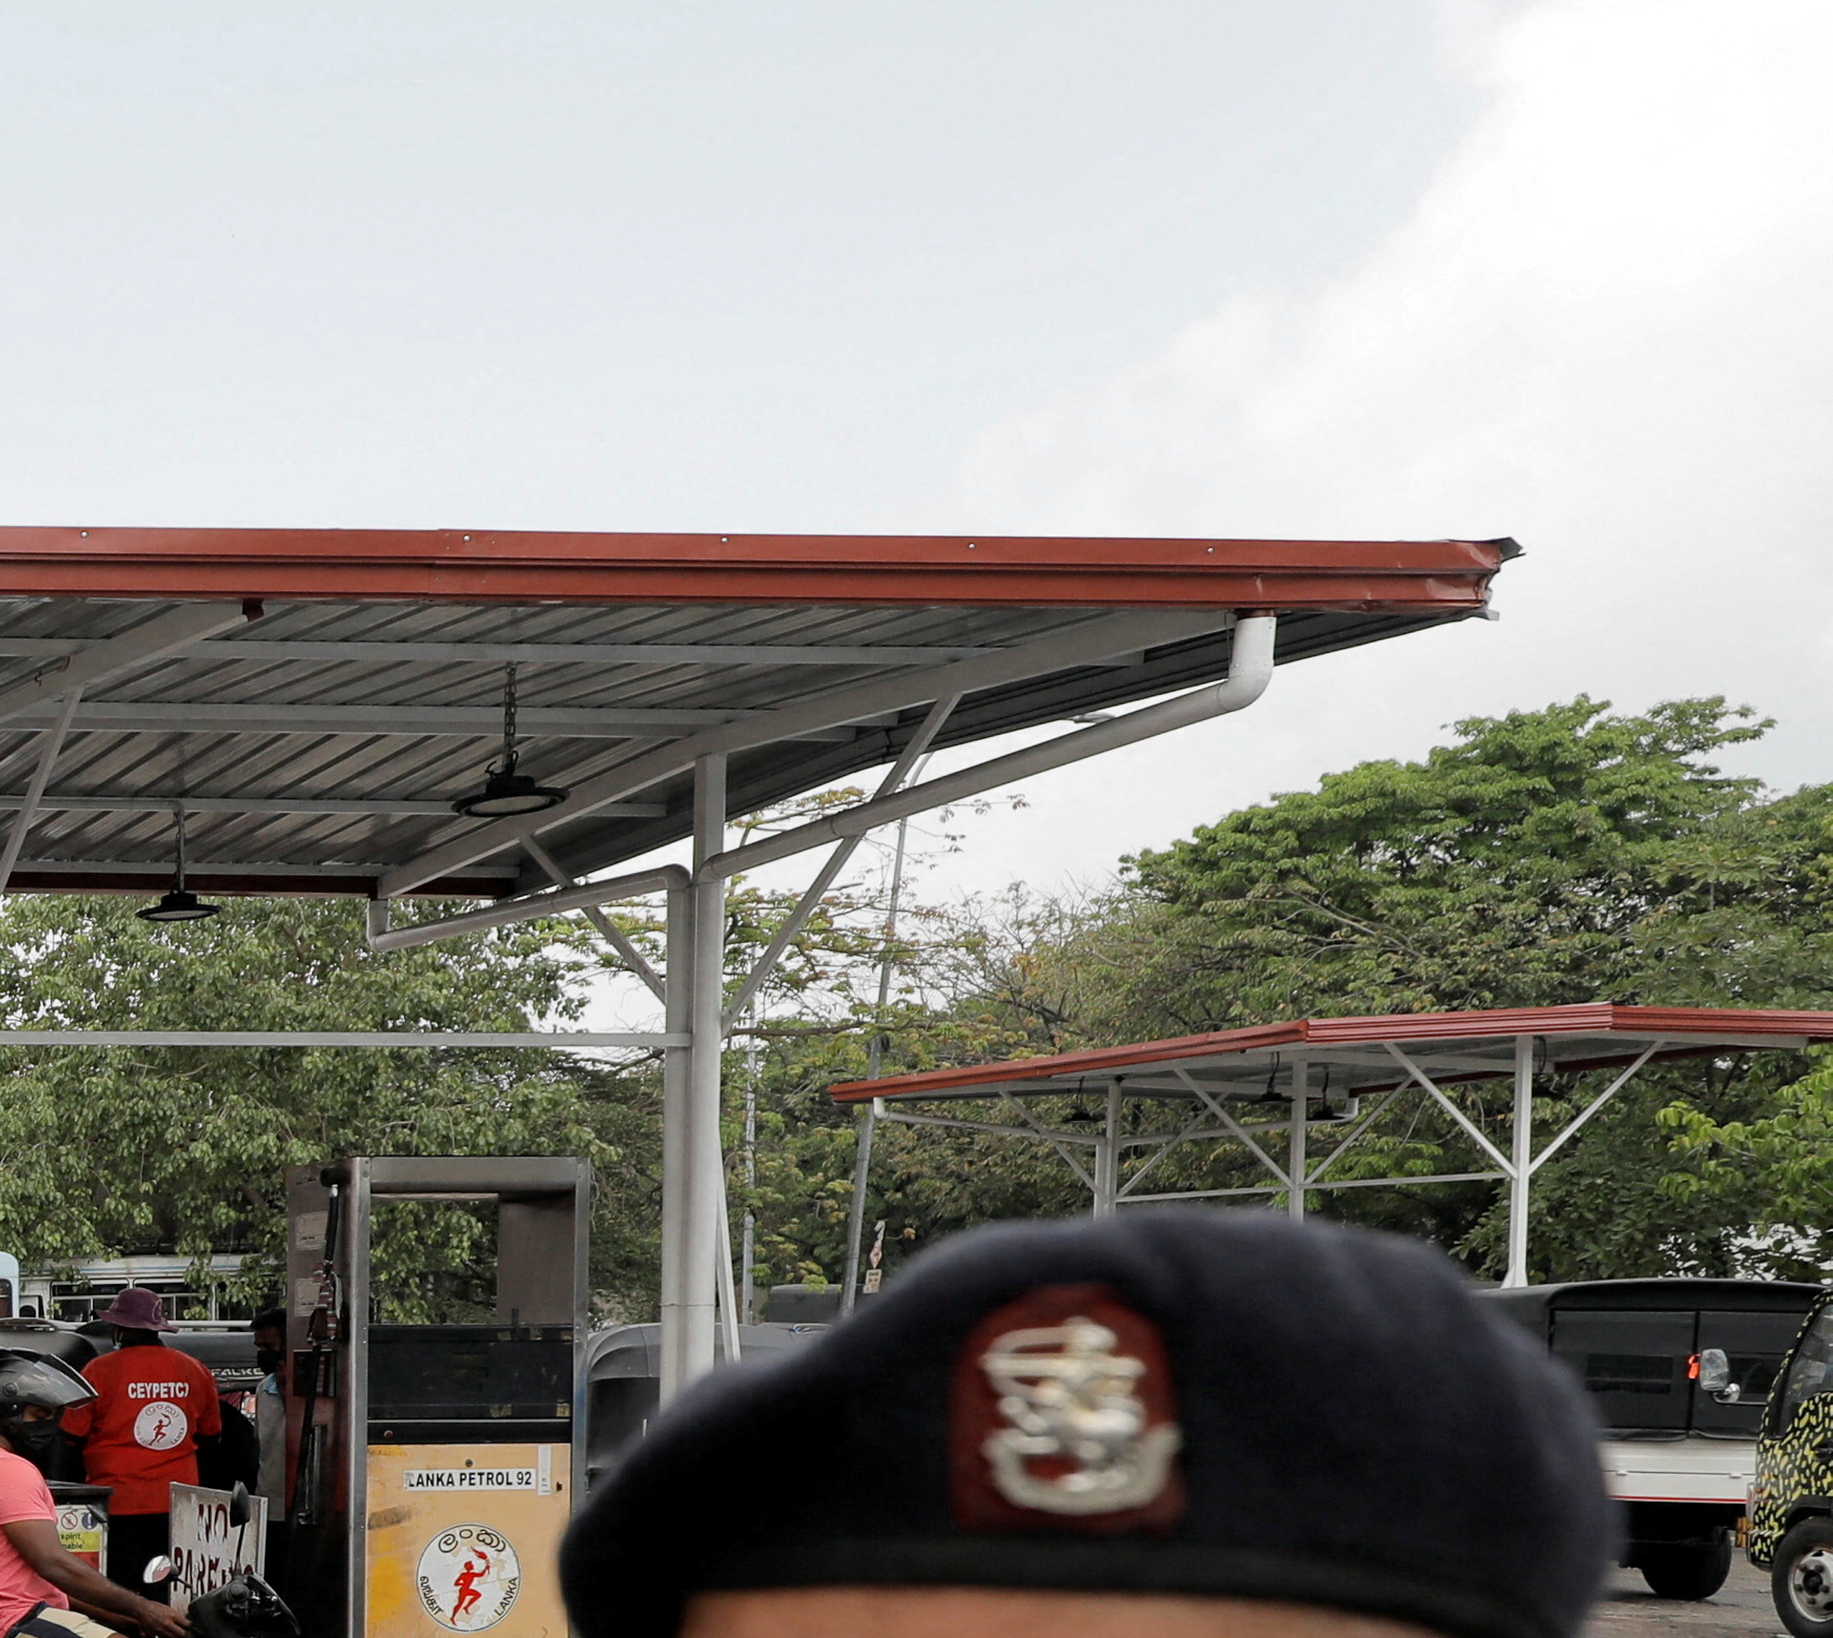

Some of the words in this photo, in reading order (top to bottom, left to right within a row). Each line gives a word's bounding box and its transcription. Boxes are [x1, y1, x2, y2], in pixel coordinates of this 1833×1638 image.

[459, 1472, 513, 1487] PETROL
[517, 1471, 532, 1485] 92
[198, 1504, 228, 1543] NO
[438, 1528, 506, 1553] ලංකා
[495, 1577, 519, 1617] LANKA
